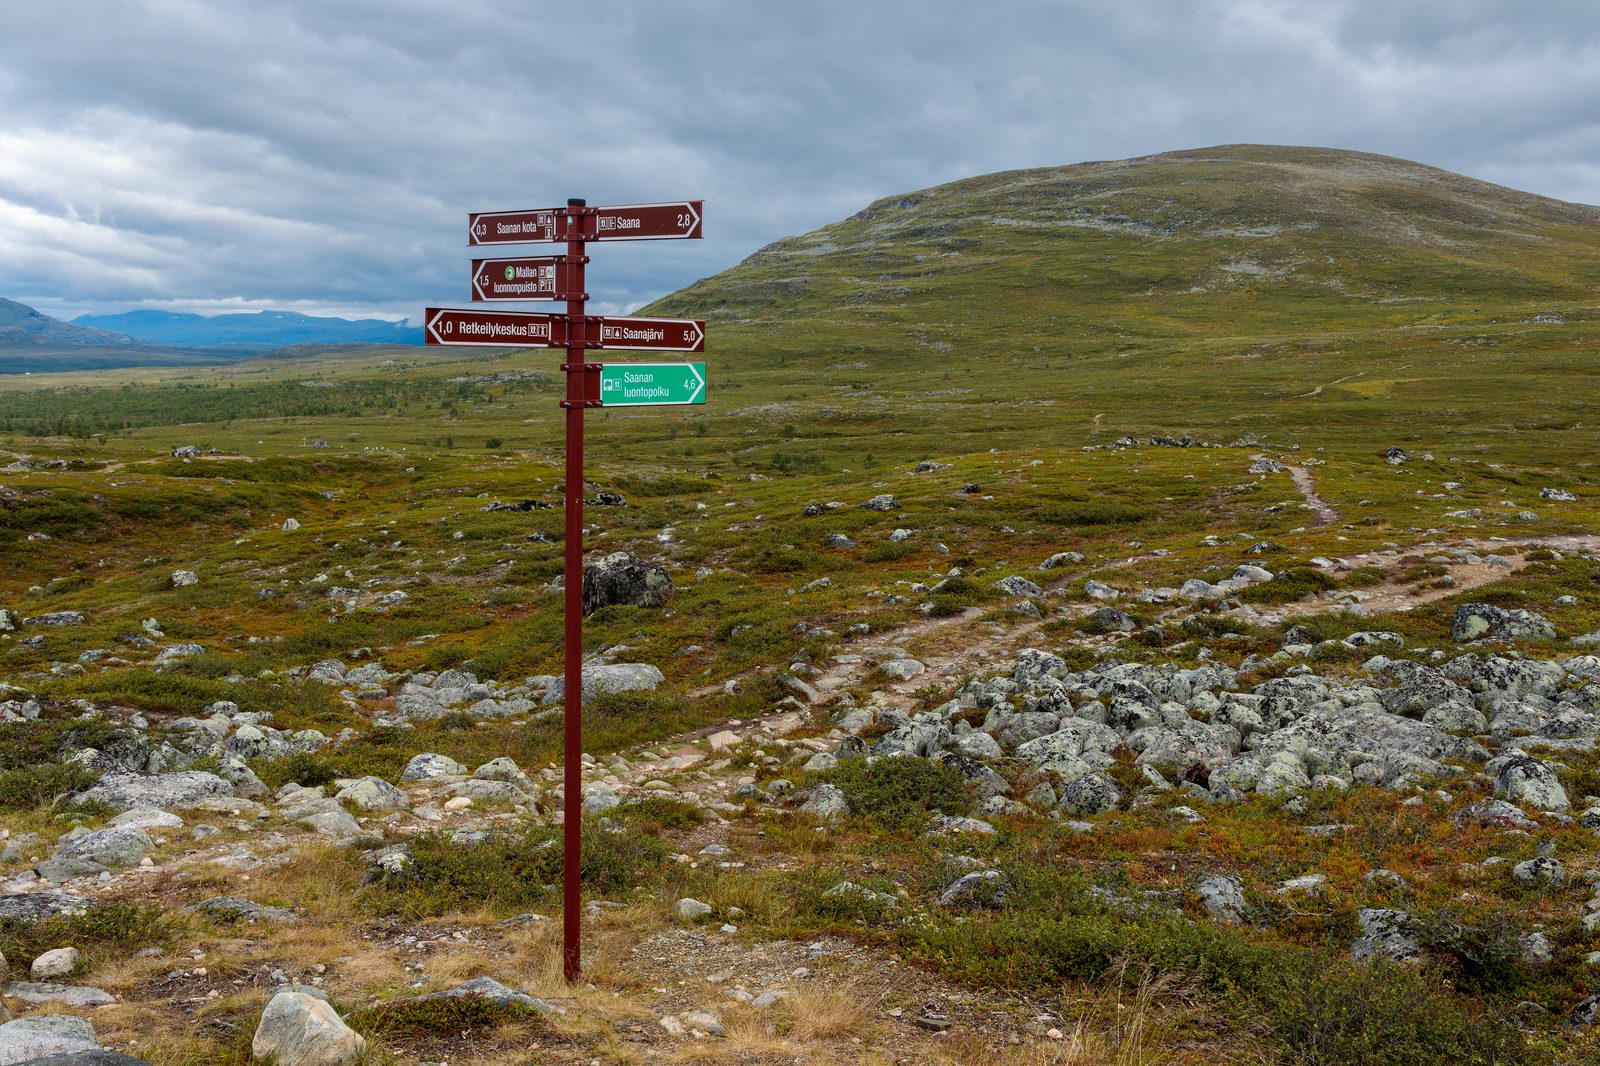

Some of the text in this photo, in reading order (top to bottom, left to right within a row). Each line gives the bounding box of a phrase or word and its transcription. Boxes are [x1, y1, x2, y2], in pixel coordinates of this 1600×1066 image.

[617, 213, 691, 229] Saana 2,8
[476, 221, 537, 237] 0,3 Saanan kota
[516, 266, 537, 278] Mallan
[479, 275, 489, 287] 1,5
[493, 281, 537, 295] luonnonpuisto
[437, 320, 527, 337] 1,0 Retkeilykeskus
[623, 327, 696, 342] Saanajärvi 5,0
[624, 371, 653, 383] Saanan
[683, 379, 696, 391] 4,6
[623, 386, 669, 399] luontopolku
